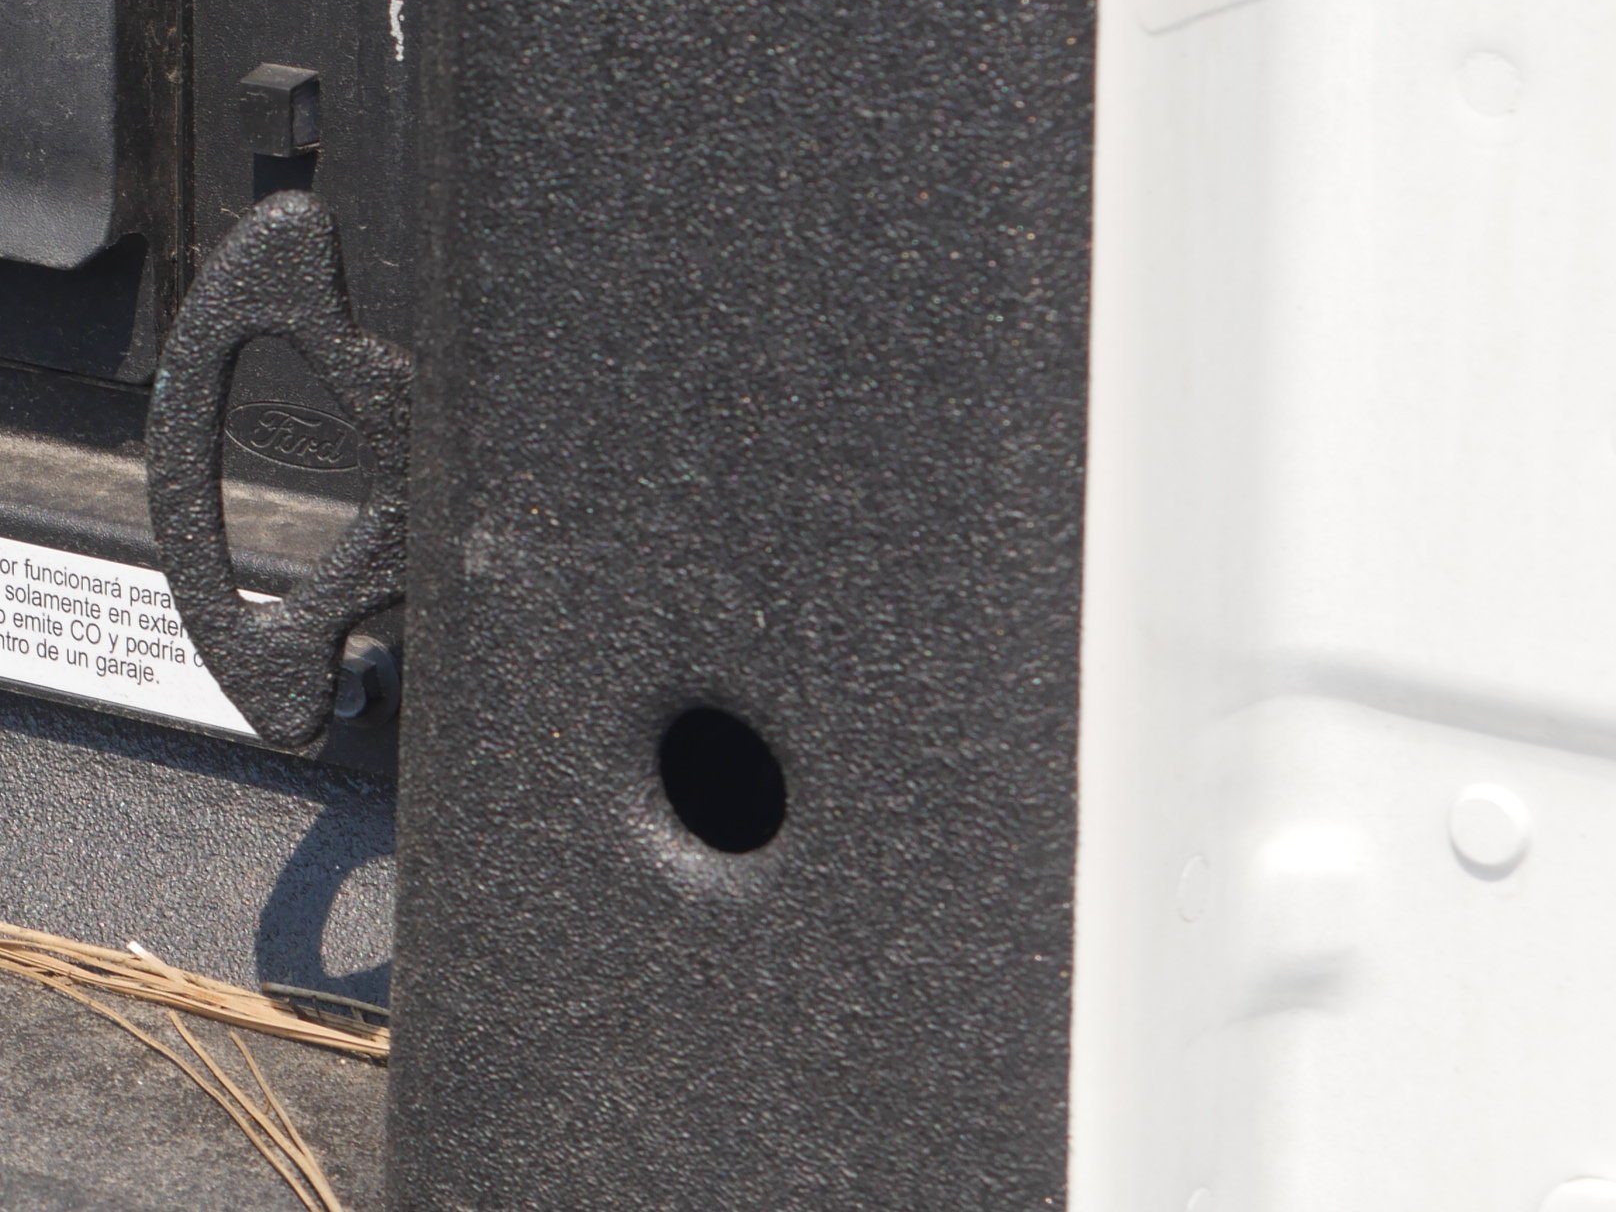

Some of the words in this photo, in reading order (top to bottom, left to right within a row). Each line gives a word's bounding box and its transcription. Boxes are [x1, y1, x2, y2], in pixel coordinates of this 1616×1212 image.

[250, 410, 346, 463] Ford
[5, 583, 101, 619] solamente
[108, 608, 131, 626] en
[24, 558, 122, 598] funcionará
[130, 586, 171, 609] para
[13, 611, 63, 637] emite
[70, 619, 101, 644] CO
[108, 632, 118, 653] y
[126, 637, 185, 664] podría
[36, 639, 59, 660] de
[66, 648, 88, 668] un
[96, 656, 159, 685] garaje.
